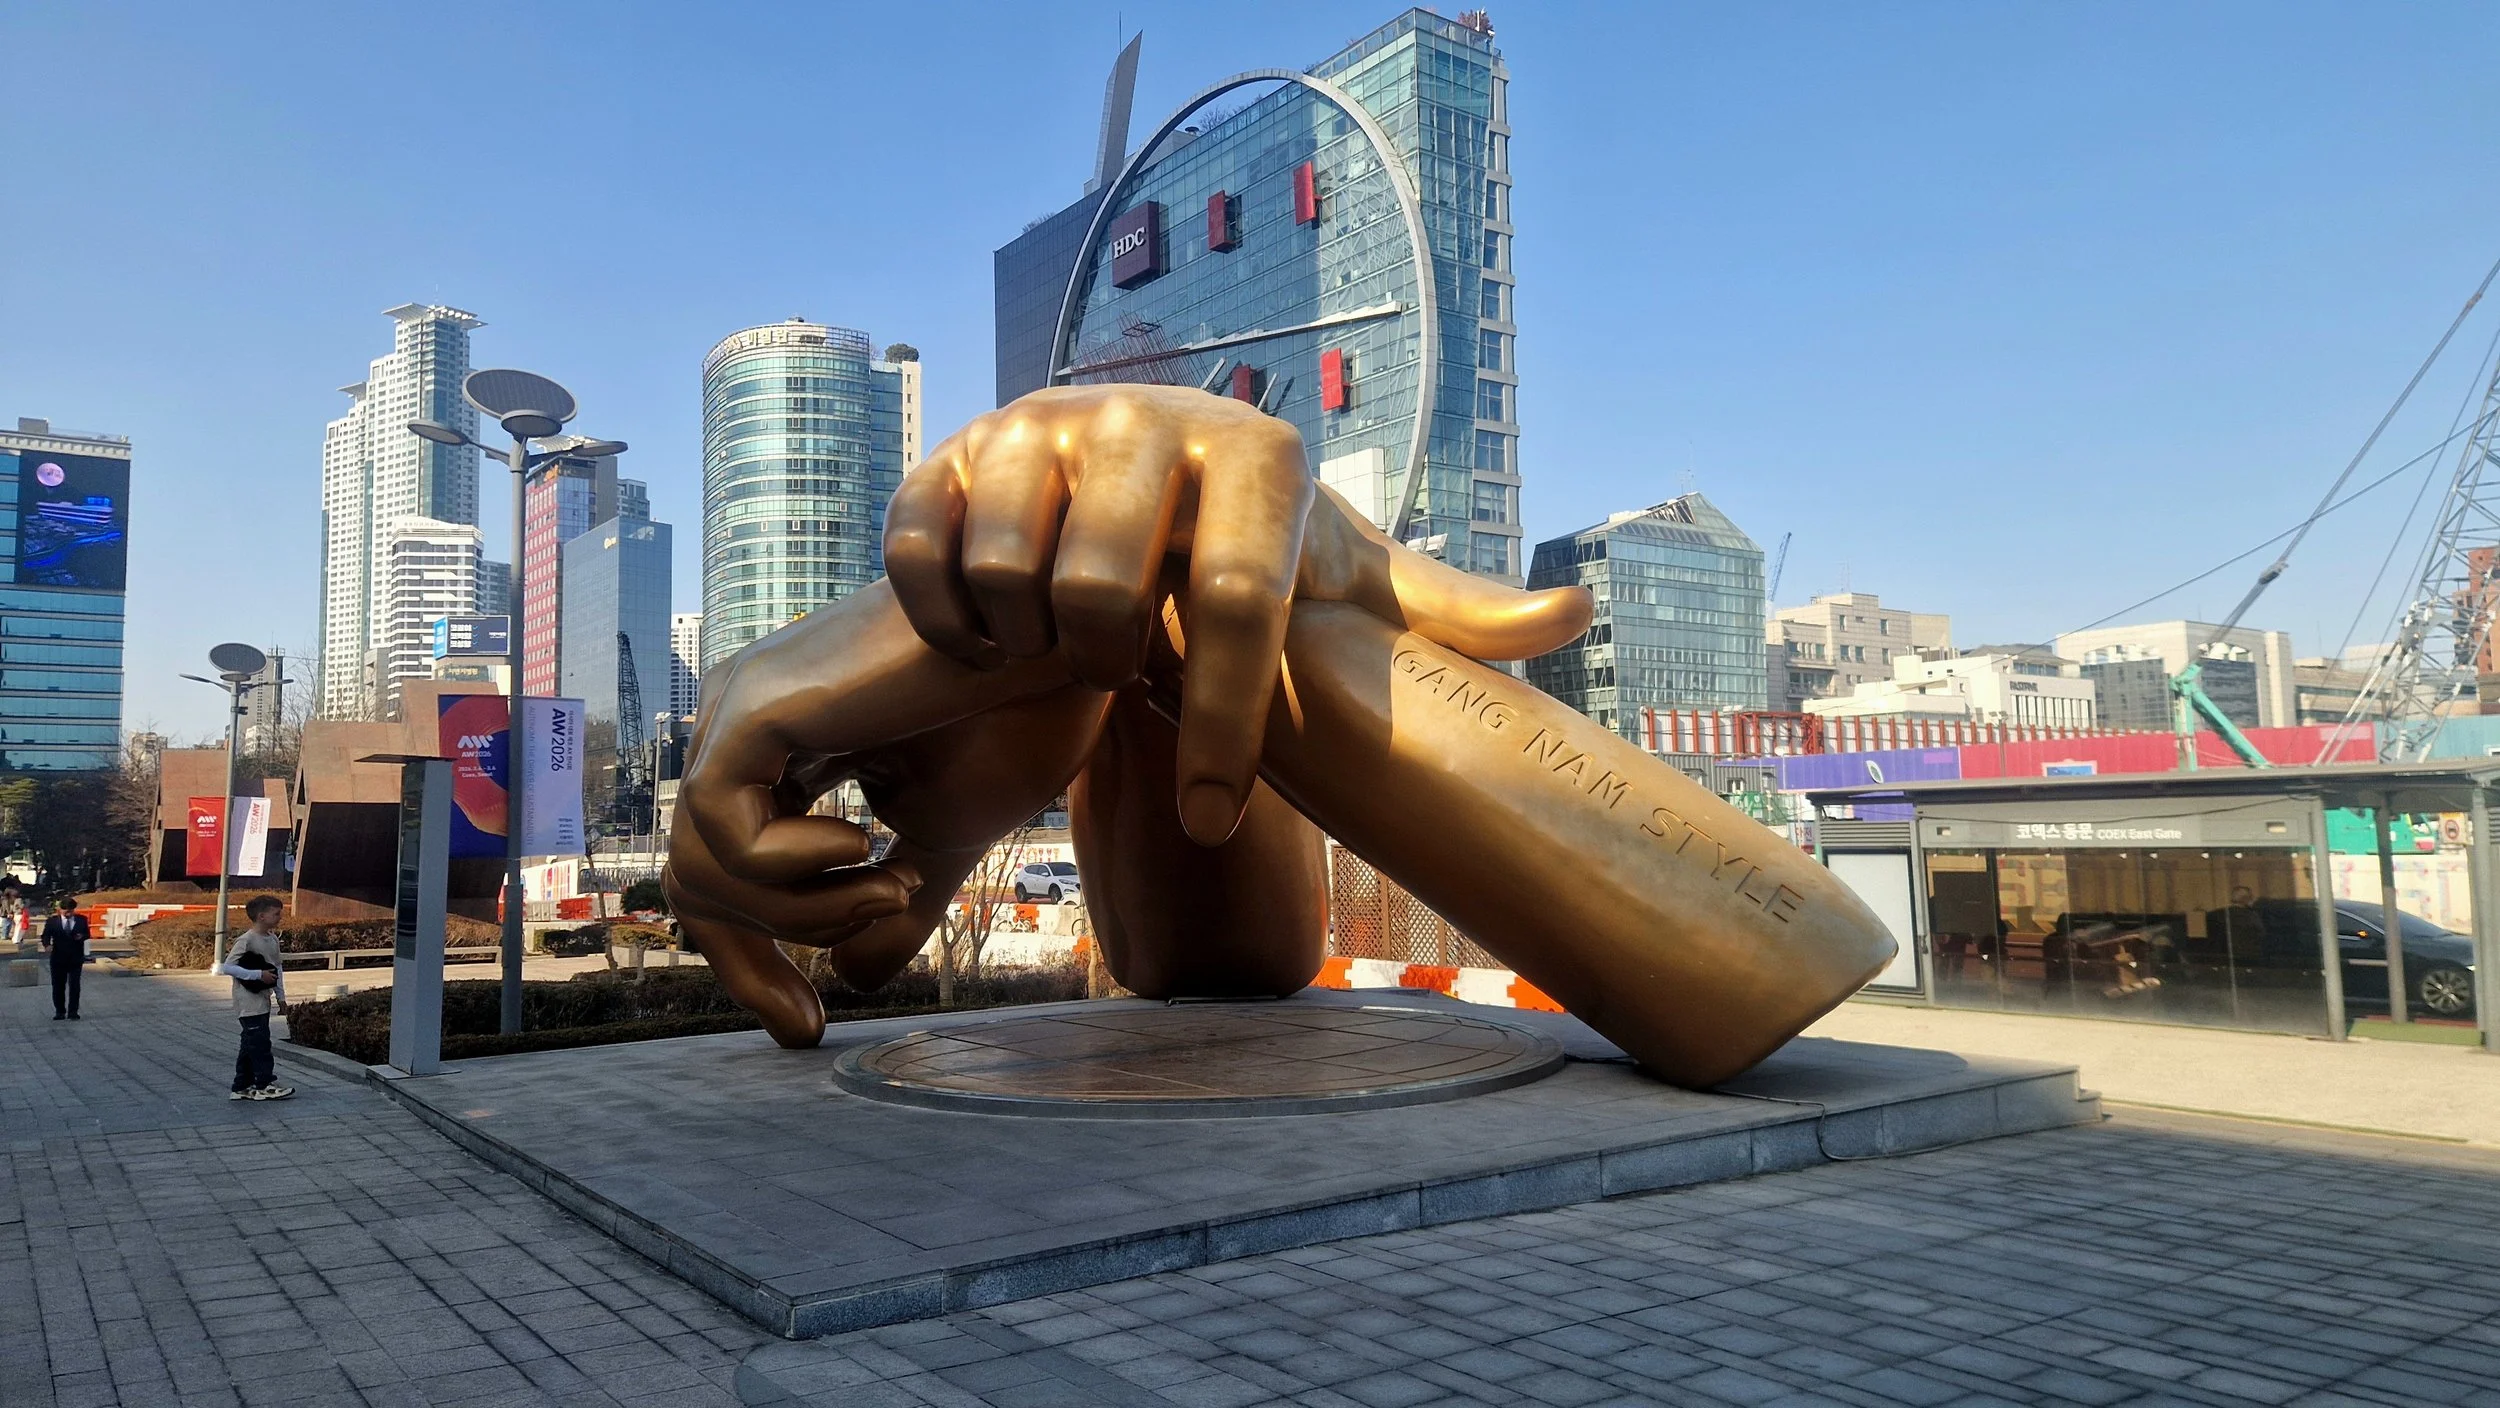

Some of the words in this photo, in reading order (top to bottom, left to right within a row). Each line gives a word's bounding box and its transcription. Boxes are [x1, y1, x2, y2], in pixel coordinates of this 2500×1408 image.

[1113, 226, 1145, 259] HDC
[1393, 650, 1520, 732] GANG
[1523, 727, 1635, 809] NAM
[1640, 807, 1806, 924] STYLE
[2015, 823, 2061, 841] 코엑스
[2061, 823, 2094, 841] 동문
[2096, 828, 2127, 840] COEX
